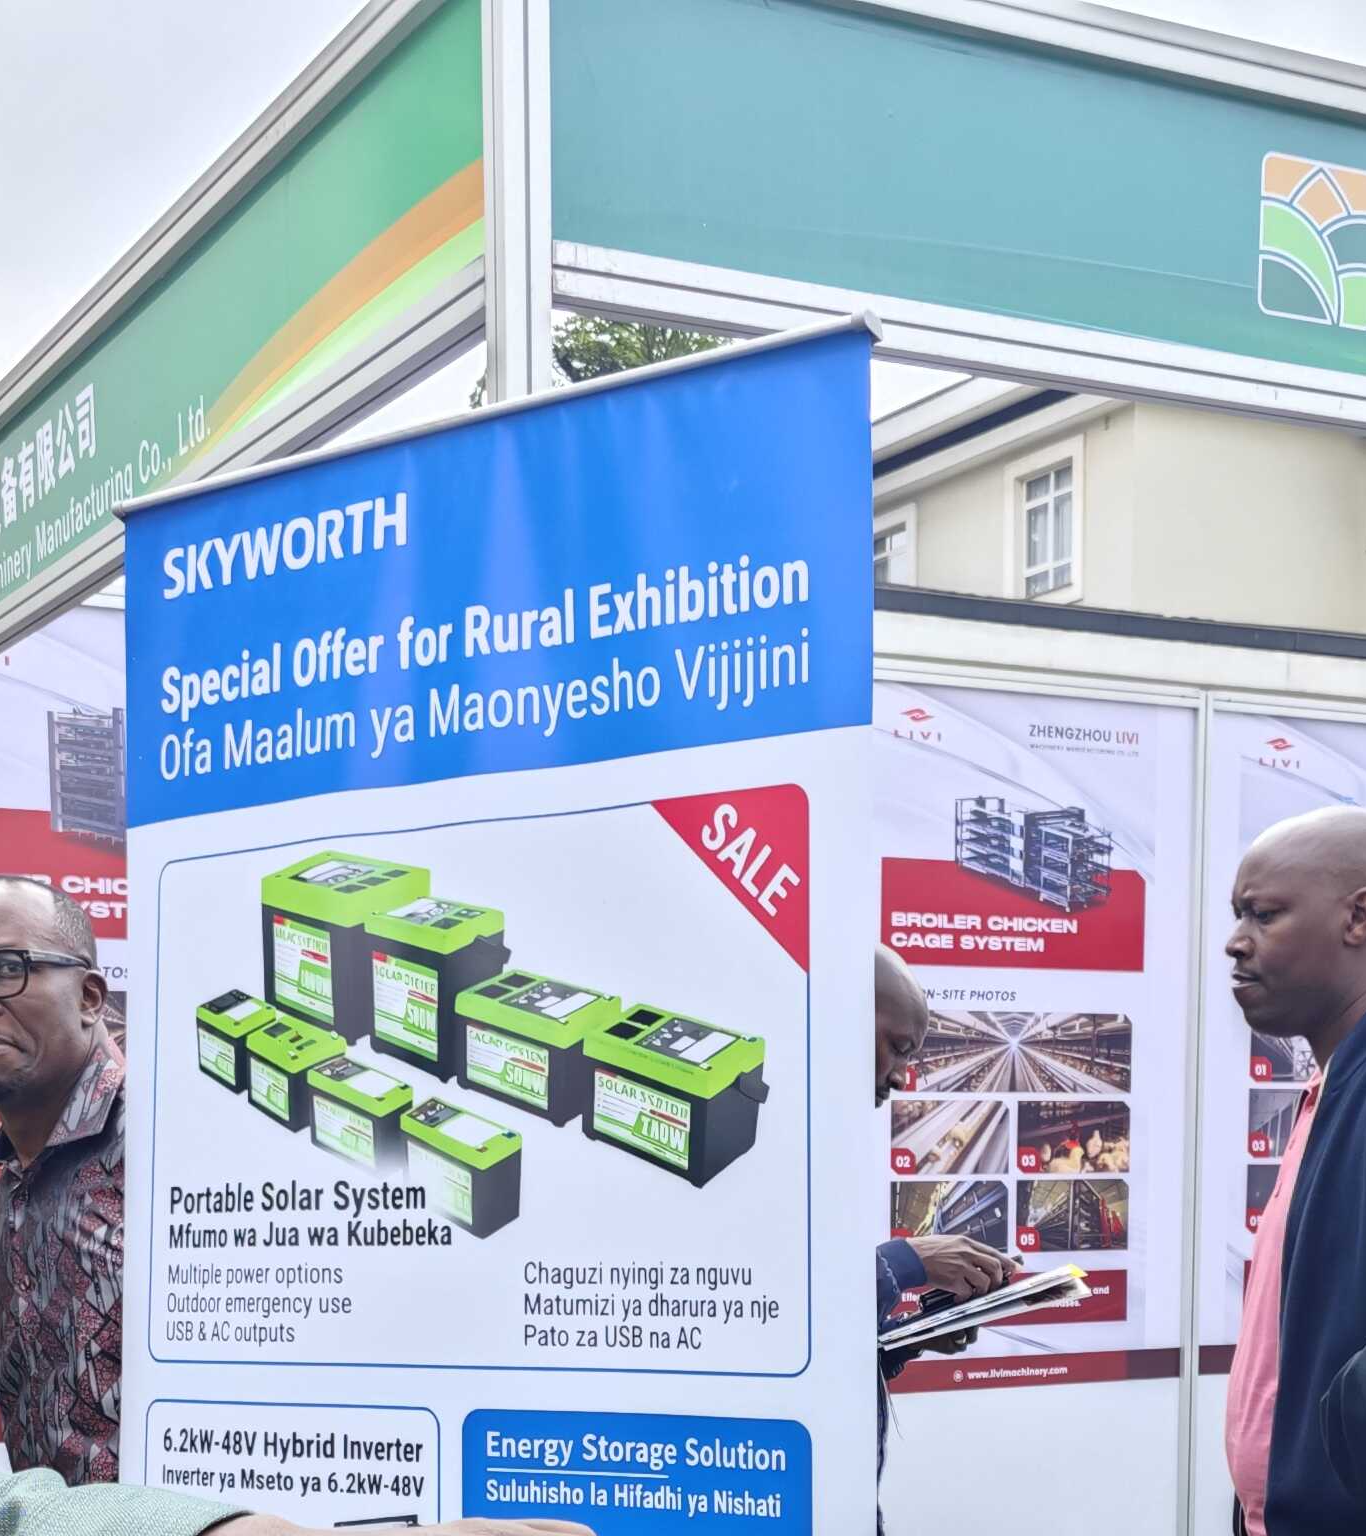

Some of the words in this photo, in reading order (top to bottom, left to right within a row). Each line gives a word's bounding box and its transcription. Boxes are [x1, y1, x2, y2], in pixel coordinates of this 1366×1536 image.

[35, 464, 133, 561] Manufacturing
[138, 439, 172, 485] Co.,
[178, 395, 212, 449] Ltd.
[162, 492, 408, 599] SKYWORTH
[161, 643, 281, 717] Special
[293, 629, 384, 687] Offer
[396, 614, 449, 669] for
[463, 588, 575, 655] Rural
[588, 555, 809, 637] Exhibition
[160, 734, 213, 781] Ofa
[223, 707, 355, 771] Maalum
[370, 705, 416, 759] ya
[428, 662, 662, 737] Maonyesho
[675, 629, 810, 711] Vijijini
[892, 728, 942, 743] LIVI
[1029, 724, 1112, 743] ZHENGZHOU
[1115, 730, 1139, 745] LIVI
[1258, 757, 1301, 770] LIVI
[701, 803, 801, 917] SALE
[891, 911, 982, 931] BROILER
[987, 915, 1078, 935] CHICKEN
[890, 934, 954, 950] CAGE
[960, 935, 1045, 953] SYSTEM
[969, 990, 1017, 1002] PHOTOS
[895, 1155, 911, 1168] 02
[1021, 1154, 1036, 1167] 03
[170, 1182, 254, 1215] Portable
[261, 1180, 324, 1211] Solar
[333, 1180, 426, 1217] System
[169, 1222, 228, 1249] Mfumo
[233, 1227, 257, 1247] wa
[263, 1222, 299, 1247] Jua
[307, 1226, 339, 1247] wa
[347, 1219, 452, 1246] Kubebeka
[1020, 1233, 1035, 1246] 05
[168, 1263, 222, 1285] Multiple
[226, 1267, 270, 1288] power
[275, 1263, 343, 1288] options
[524, 1261, 603, 1290] Chaguzi
[610, 1261, 664, 1290] nyingi
[670, 1266, 690, 1286] za
[696, 1266, 752, 1291] nguvu
[167, 1292, 221, 1314] Outdoor
[225, 1295, 312, 1319] emergency
[319, 1296, 352, 1314] use
[524, 1293, 615, 1316] Matumizi
[622, 1298, 642, 1322] ya
[648, 1294, 717, 1317] dharura
[723, 1300, 744, 1324] ya
[750, 1295, 780, 1325] nje
[166, 1320, 194, 1341] USB
[198, 1322, 207, 1342] &
[211, 1320, 231, 1342] AC
[234, 1322, 295, 1347] outputs
[524, 1324, 569, 1346] Pato
[576, 1329, 598, 1347] za
[605, 1325, 643, 1348] USB
[649, 1330, 671, 1349] na
[677, 1326, 702, 1350] AC
[163, 1426, 256, 1458] 6.2kW-48V
[263, 1430, 336, 1463] Hybrid
[342, 1433, 423, 1464] Inverter
[486, 1430, 574, 1467] Energy
[582, 1434, 677, 1471] Storage
[685, 1437, 786, 1471] Solution
[162, 1464, 215, 1488] Inverter
[218, 1472, 236, 1492] ya
[240, 1468, 295, 1492] Mseto
[299, 1474, 322, 1498] ya
[327, 1472, 425, 1499] 6.2kW-48V
[485, 1479, 584, 1505] Suluhisho
[590, 1482, 608, 1507] la
[614, 1483, 682, 1511] Hifadhi
[687, 1493, 708, 1518] ya
[714, 1490, 782, 1518] Nishati
